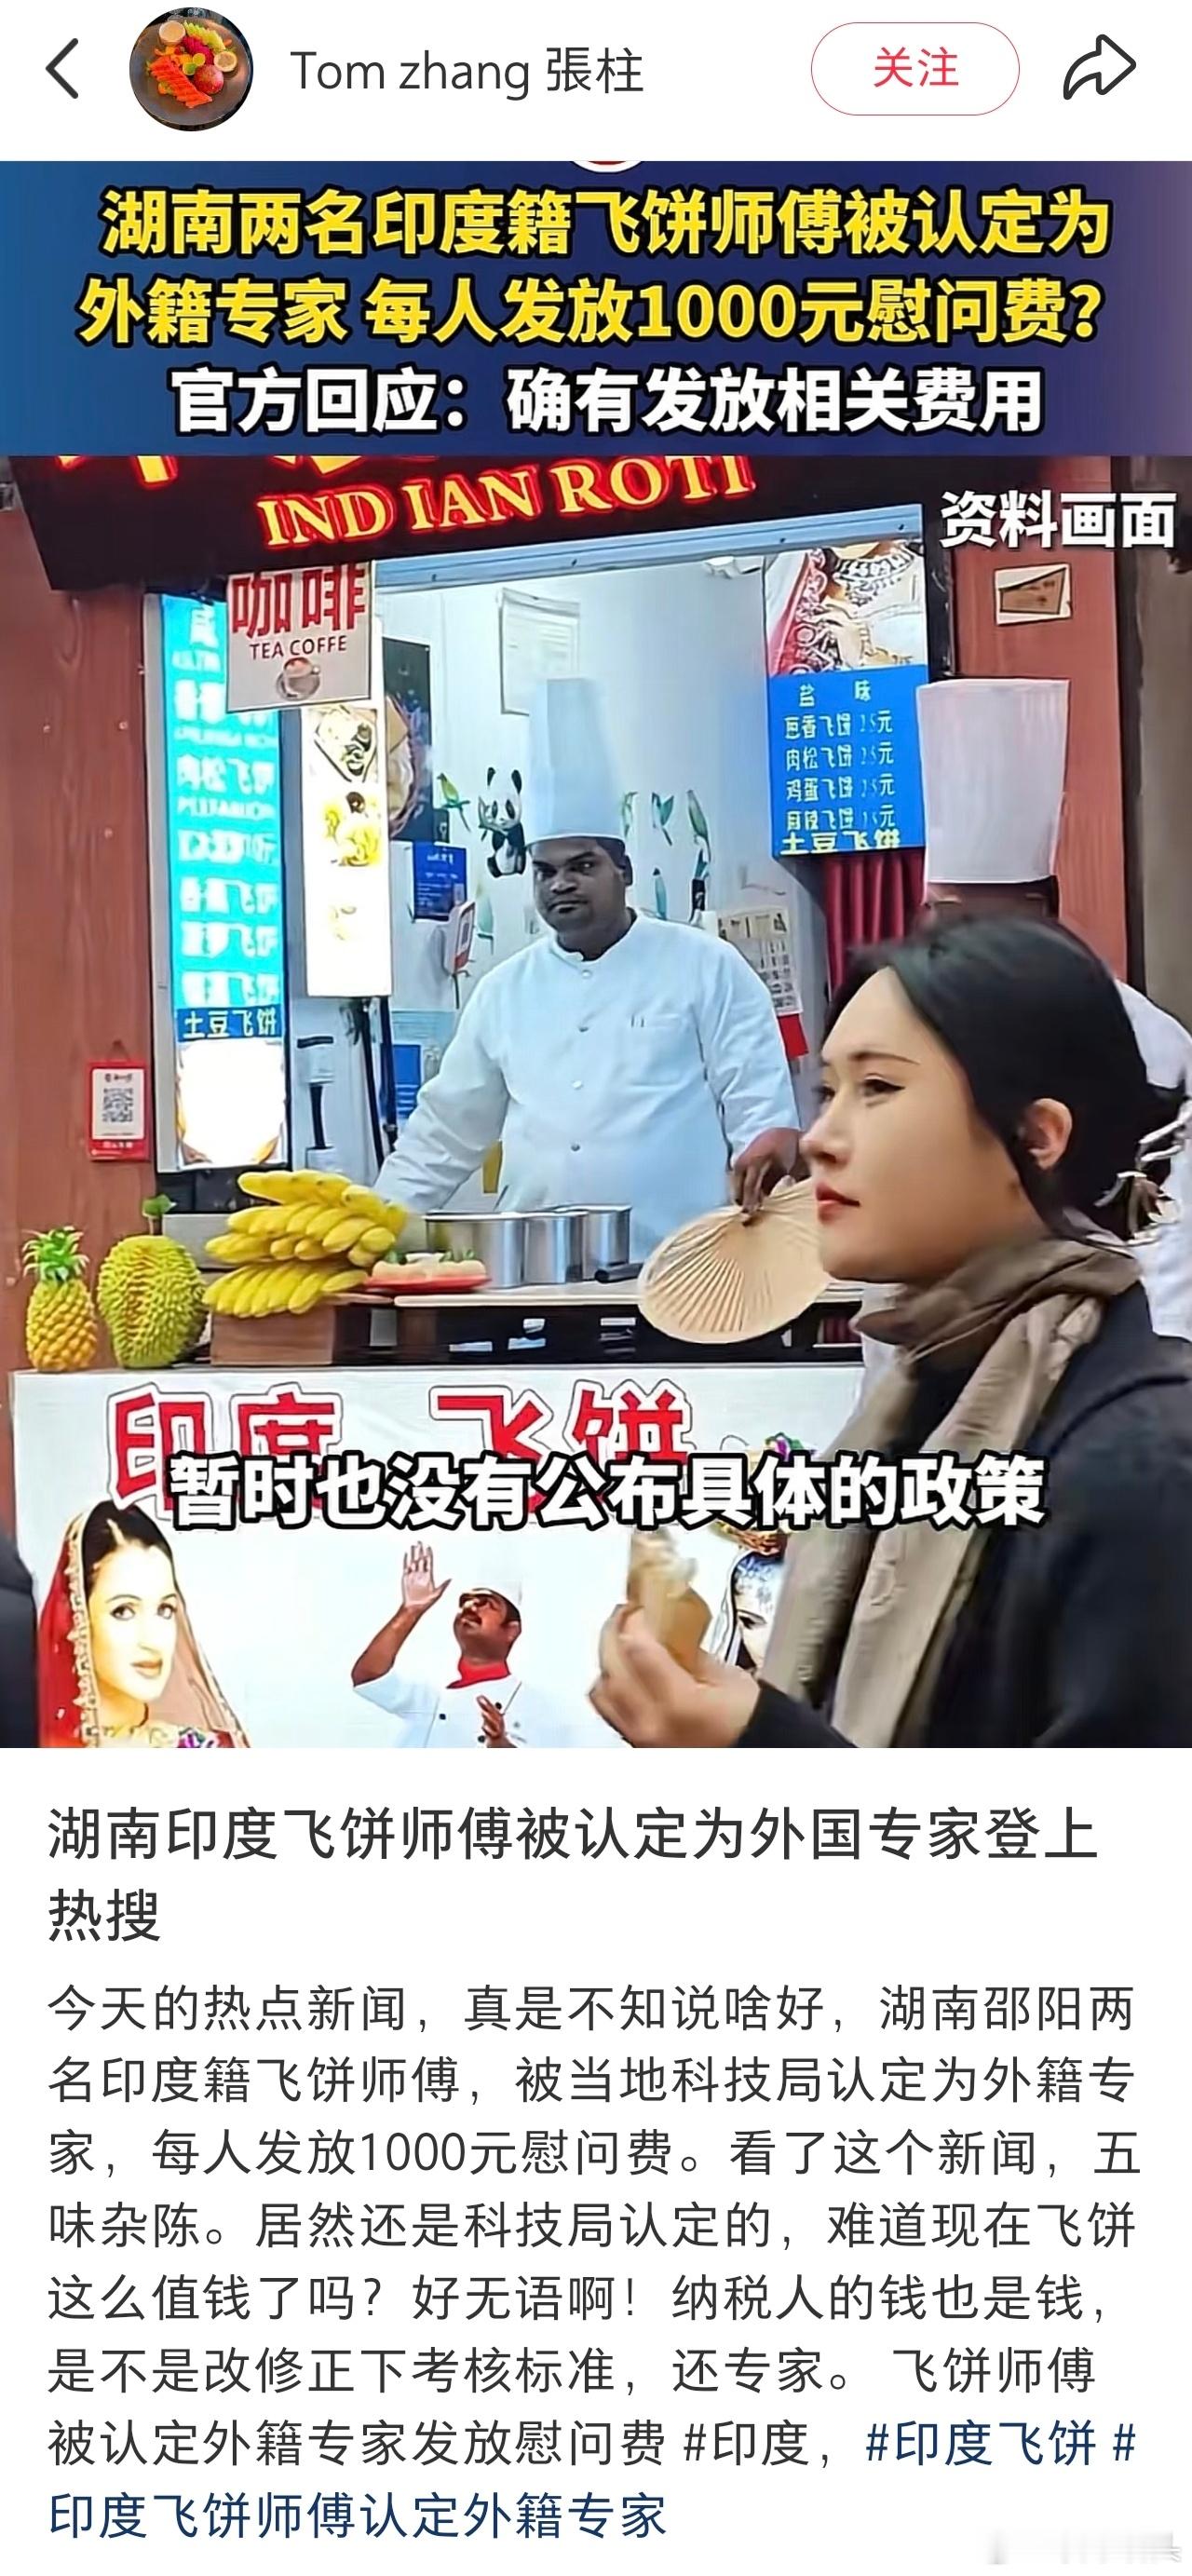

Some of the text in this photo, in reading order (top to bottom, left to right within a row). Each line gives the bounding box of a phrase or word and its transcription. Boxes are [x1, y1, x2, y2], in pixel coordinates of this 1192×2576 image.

[550, 454, 752, 514] ROTI
[231, 562, 367, 639] 咖啡
[249, 635, 348, 660] TEA COFFE
[779, 828, 901, 855] 土豆飞饼
[182, 1006, 278, 1039] 土豆飞饼
